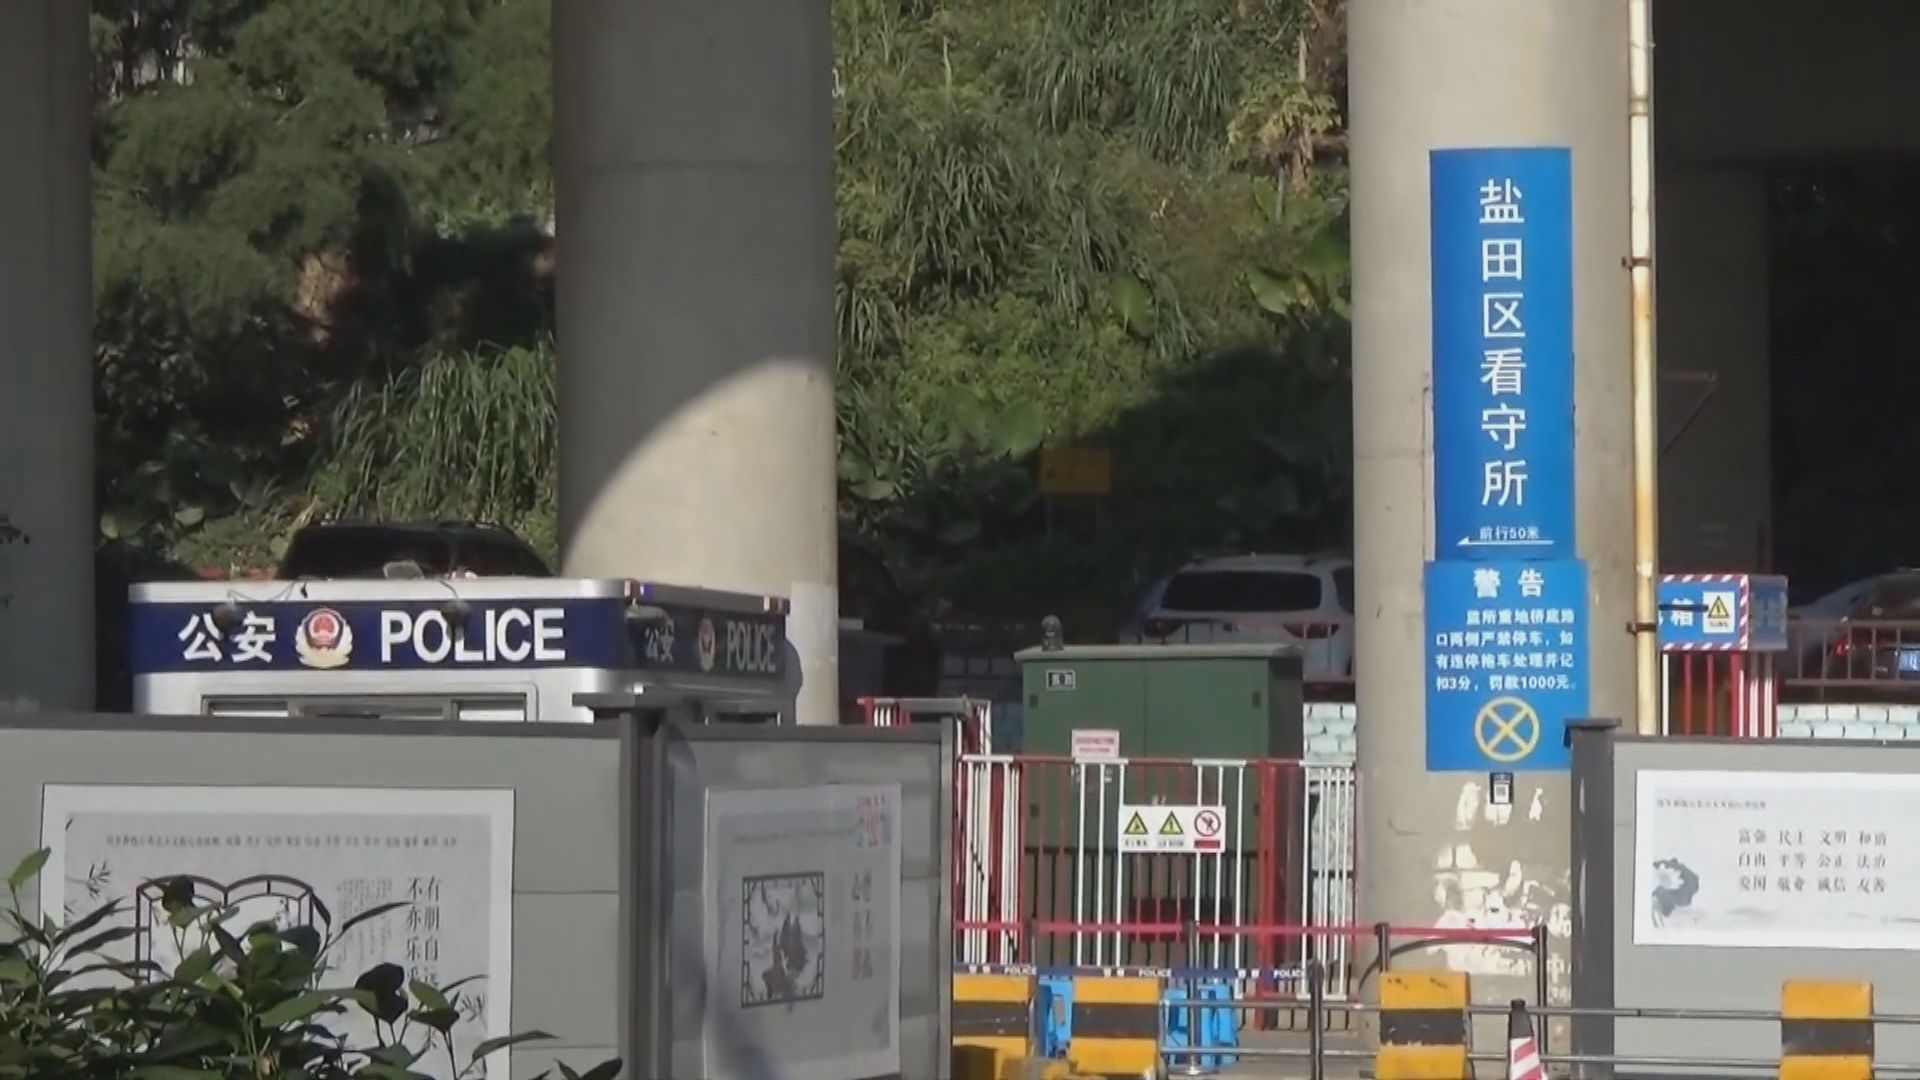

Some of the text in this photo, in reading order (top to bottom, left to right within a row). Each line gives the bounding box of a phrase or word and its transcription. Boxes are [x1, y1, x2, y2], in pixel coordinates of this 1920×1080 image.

[1480, 178, 1528, 506] 盐田区看守所
[1480, 526, 1540, 541] 前行50米
[1473, 567, 1545, 598] 警告
[178, 611, 276, 662] 公安
[381, 607, 566, 663] POLICE
[726, 620, 777, 673] POLICE
